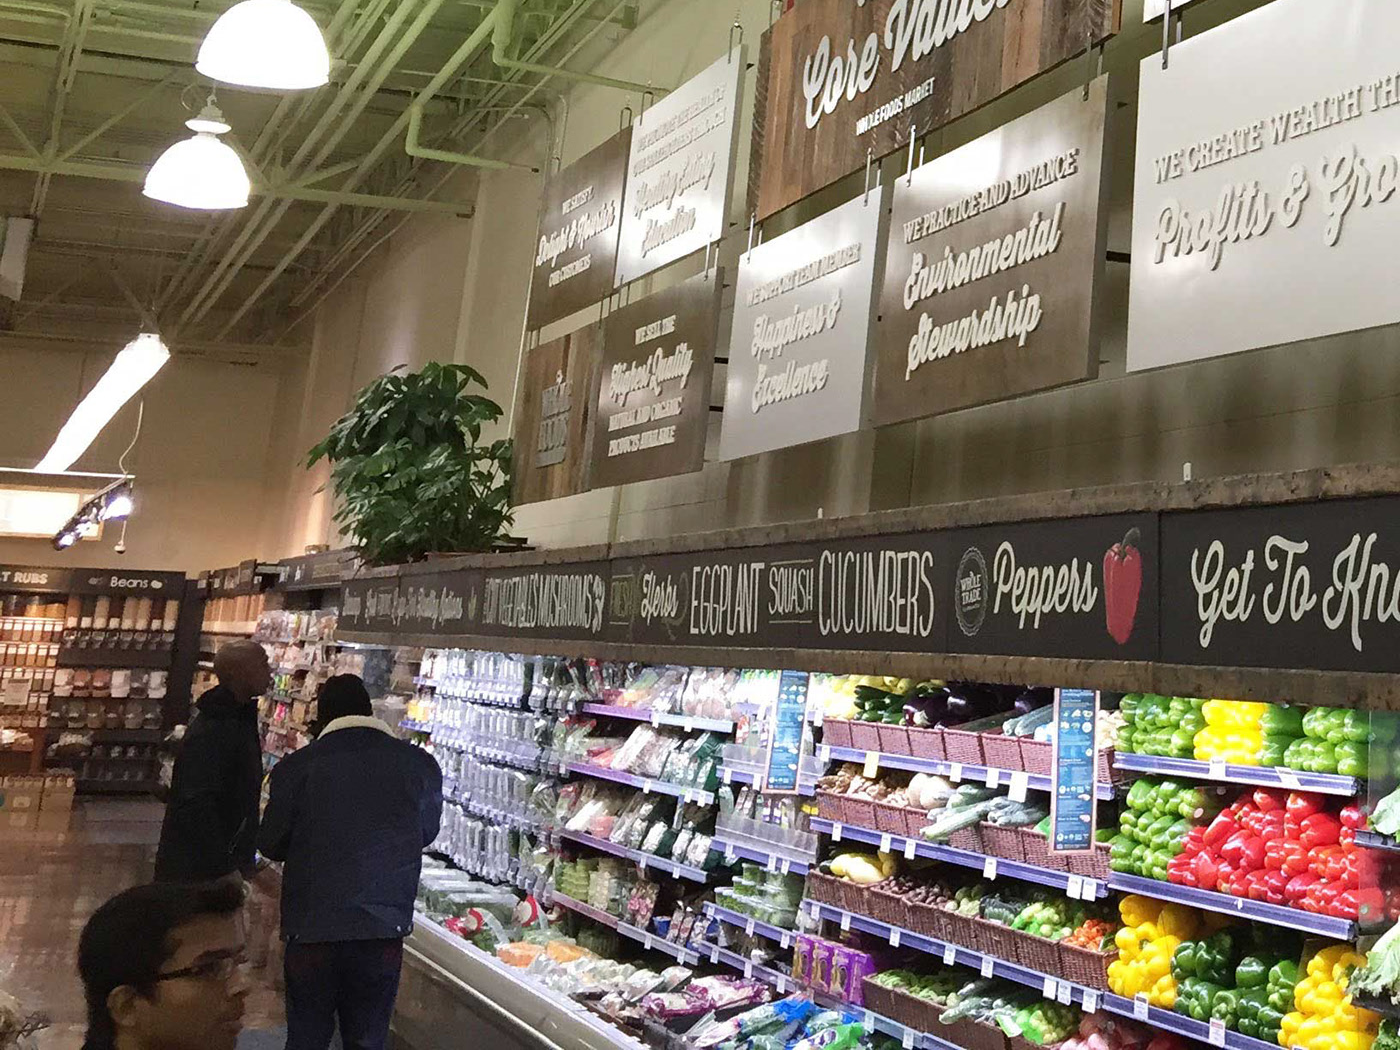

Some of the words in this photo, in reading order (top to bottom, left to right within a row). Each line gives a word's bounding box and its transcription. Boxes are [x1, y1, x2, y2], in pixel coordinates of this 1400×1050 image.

[803, 33, 880, 130] Core
[1153, 147, 1184, 184] WE
[1185, 120, 1264, 173] CREATE
[1269, 87, 1362, 146] WEALTH
[903, 217, 924, 244] WE
[922, 192, 981, 237] PRACTICE
[980, 180, 1010, 212] AND
[1011, 148, 1080, 200] ADVANCE
[1153, 180, 1273, 272] Profits
[1278, 163, 1310, 229] &
[903, 201, 1066, 310] Environmental
[751, 304, 827, 359] Happiness
[905, 284, 1043, 382] Stewardship
[751, 358, 829, 414] Excellence
[13, 571, 49, 585] RUBS
[110, 576, 149, 589] Beans
[641, 569, 679, 626] Herbs
[689, 562, 765, 635] EGGPLANT
[768, 566, 814, 616] SQUASH
[818, 550, 935, 637] CUCUMBERS
[992, 540, 1098, 630] Peppers
[1191, 539, 1256, 649] Get
[1263, 533, 1317, 625] To
